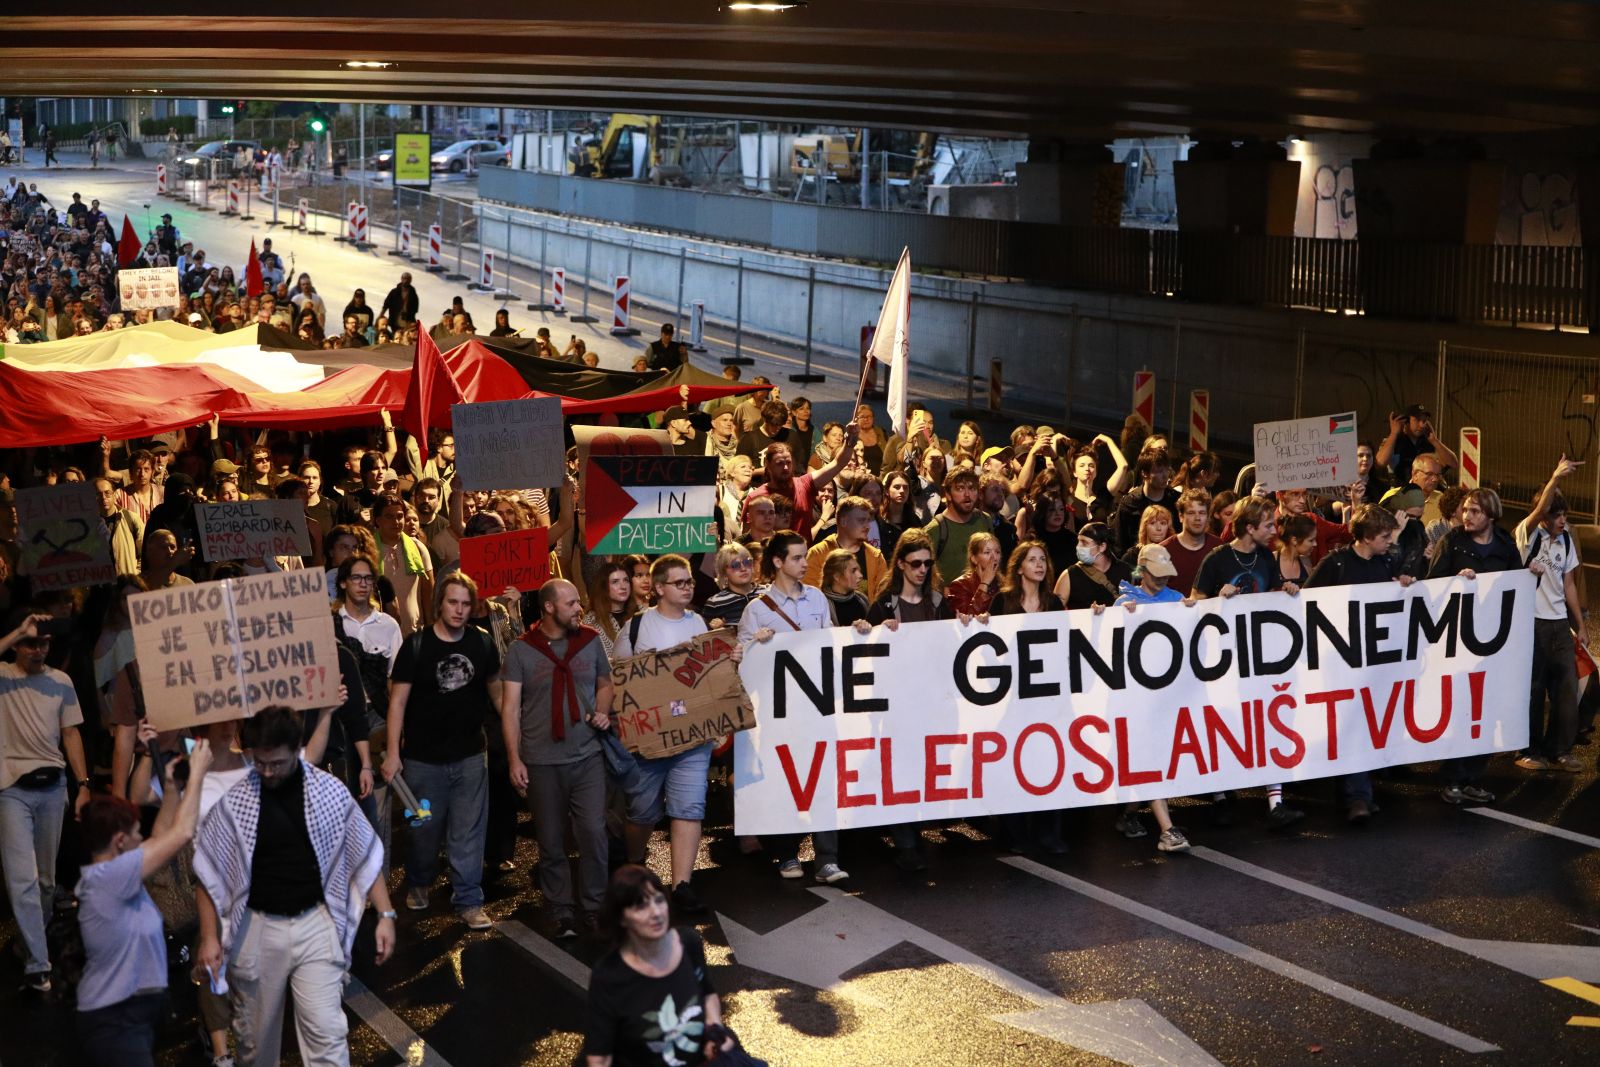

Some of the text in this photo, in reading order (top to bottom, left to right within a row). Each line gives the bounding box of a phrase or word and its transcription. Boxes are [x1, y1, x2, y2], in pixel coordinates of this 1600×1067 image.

[1257, 424, 1320, 448] A child in
[1275, 439, 1338, 459] PALESTINE
[620, 459, 697, 483] PEACE
[1258, 453, 1340, 472] has seen more blood
[1277, 471, 1298, 483] than
[202, 503, 260, 521] IZRAEL
[658, 491, 686, 514] IN
[205, 517, 297, 534] BOMBARDIRA
[206, 533, 246, 544] NATO
[618, 522, 716, 550] PALESTINE
[208, 536, 299, 558] FINANCIRA
[484, 537, 535, 566] SMRT
[132, 571, 322, 625] KOLIKO ŽIVLJENJ
[159, 611, 294, 655] JE VREDEN
[165, 640, 316, 688] EN POSLOVNI
[673, 637, 735, 688] DIVA
[773, 588, 1516, 718] NE GENOCIDNEMU
[193, 666, 326, 716] DOGOVOR?!
[610, 705, 663, 739] MRT
[775, 670, 1486, 812] VELEPOSLANIŠTVU!
